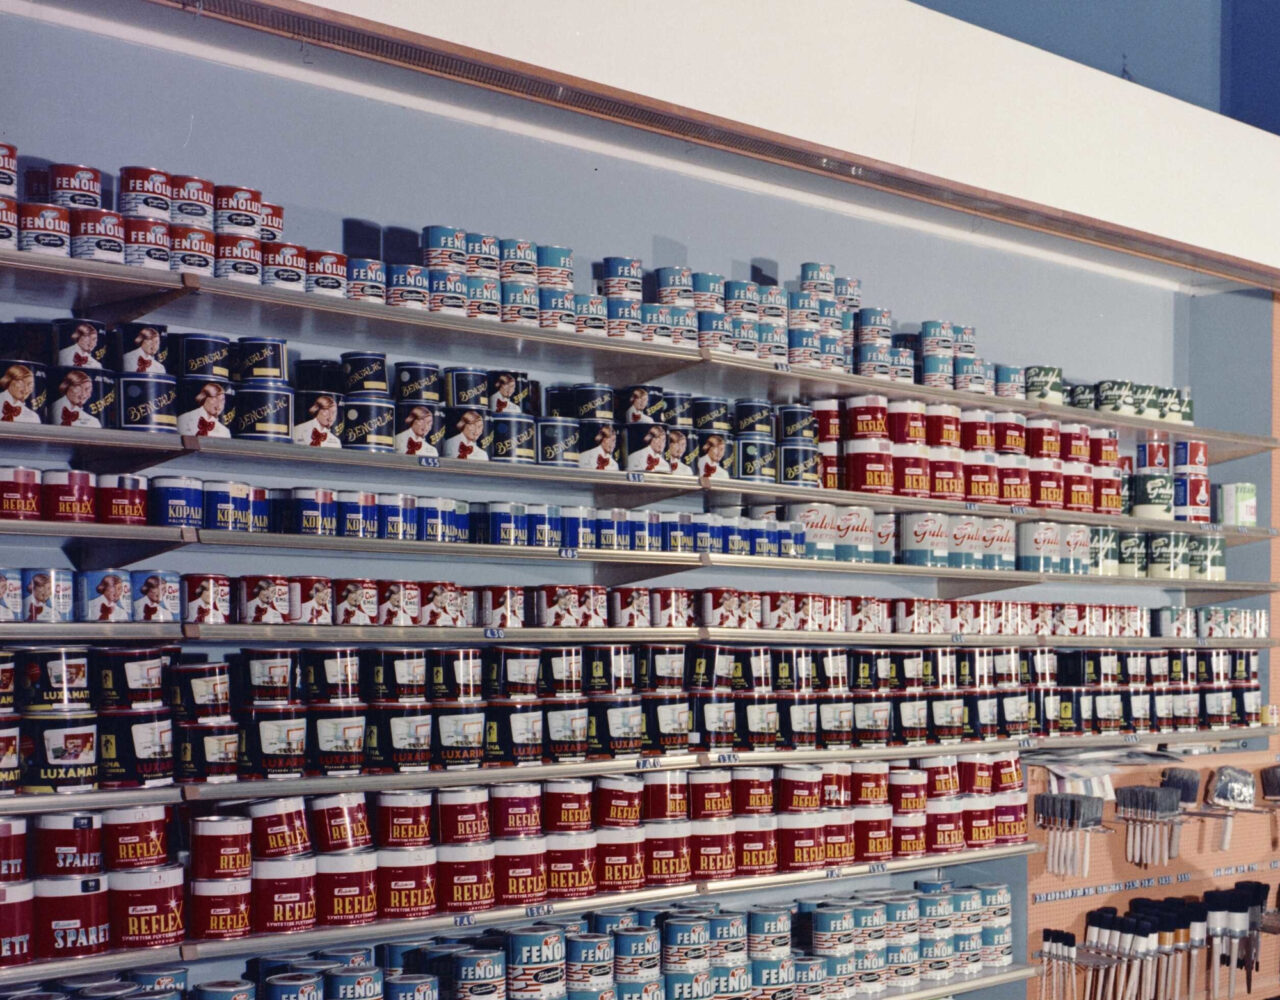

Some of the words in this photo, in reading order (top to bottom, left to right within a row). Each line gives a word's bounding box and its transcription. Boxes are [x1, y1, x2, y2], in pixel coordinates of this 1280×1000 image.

[421, 457, 439, 467] 4.55
[2, 497, 38, 513] REFLEX
[59, 498, 93, 514] REFLEX
[112, 501, 144, 517] REFLEX
[508, 806, 541, 828] REFLEX
[561, 801, 591, 822] REFLEX
[610, 798, 641, 819] REFLEX
[268, 821, 308, 849] REFLEX
[331, 816, 370, 839] REFLEX
[458, 814, 490, 836] REFLEX
[119, 832, 163, 859] REFLEX
[742, 844, 778, 866] REFLEX
[604, 854, 644, 882] REFLEX
[652, 853, 691, 876] REFLEX
[700, 848, 736, 871] REFLEX
[508, 866, 547, 895] REFLEX
[550, 860, 596, 889] REFLEX
[453, 874, 494, 902] REFLEX
[272, 899, 316, 923] REFLEX
[333, 891, 378, 916] REFLEX
[128, 901, 183, 935] REFLEX
[209, 907, 251, 929] REFLEX
